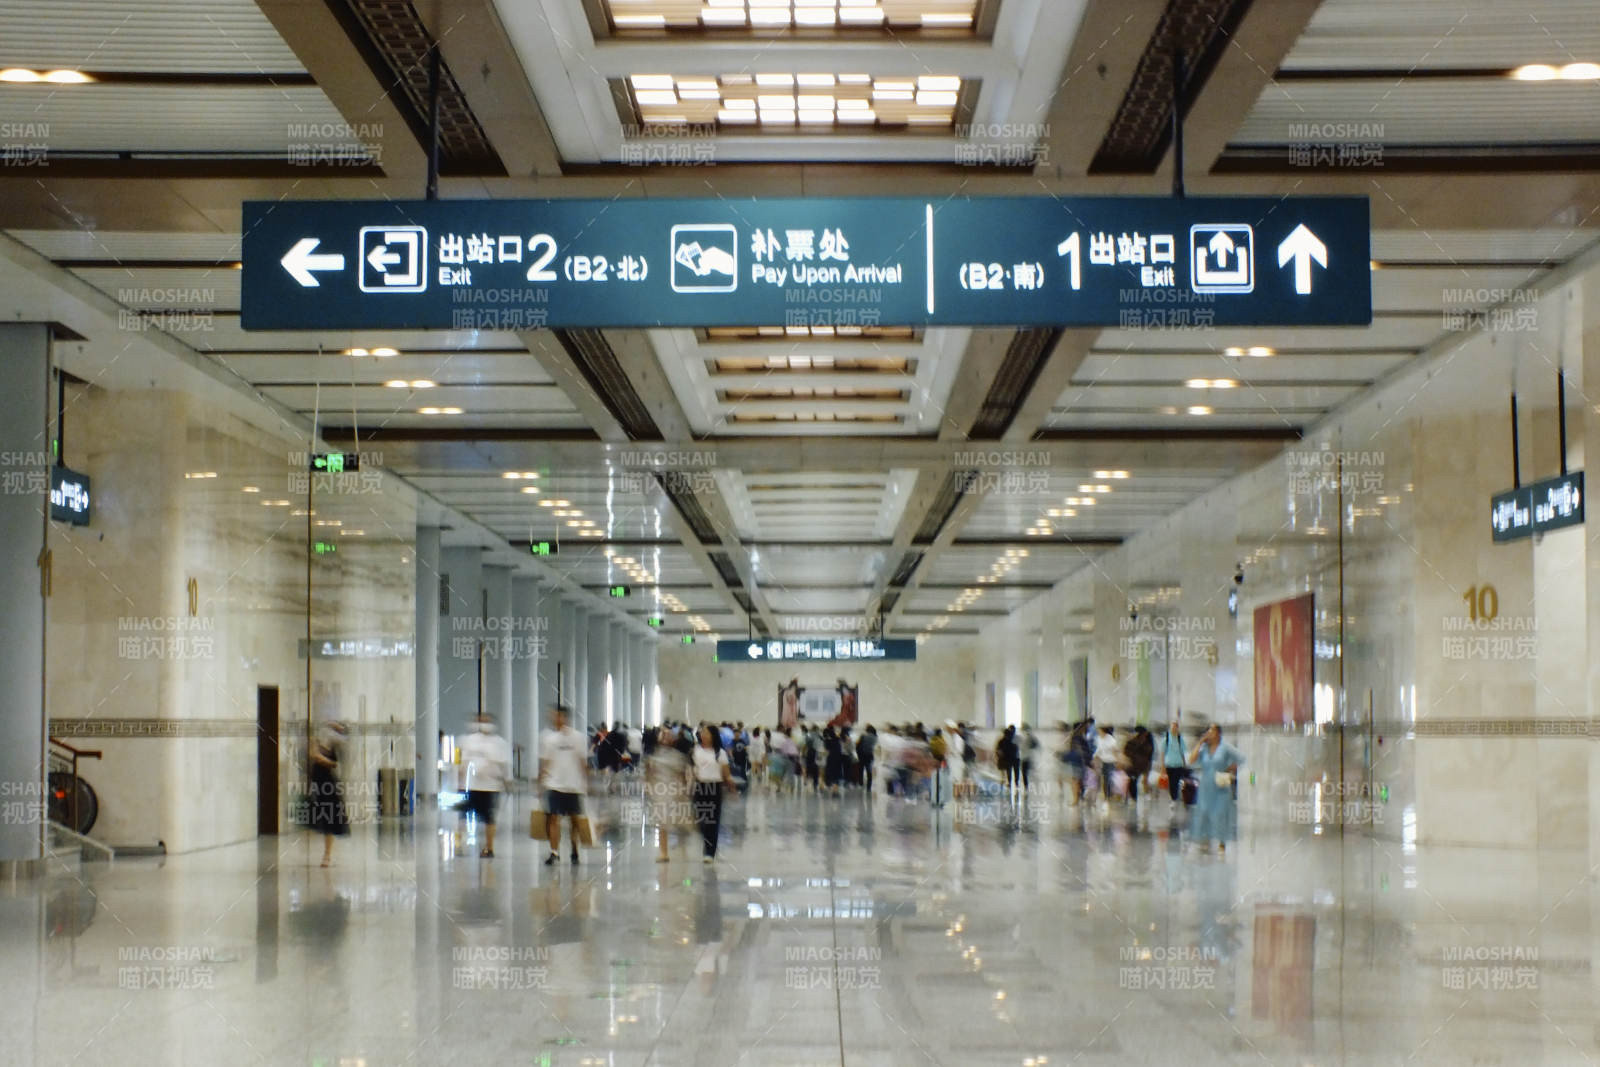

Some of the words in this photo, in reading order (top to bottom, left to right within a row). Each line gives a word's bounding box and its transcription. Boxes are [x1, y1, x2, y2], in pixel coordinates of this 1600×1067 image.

[438, 233, 523, 265] 出站口
[526, 233, 558, 282] 2
[751, 228, 850, 262] 补票处
[1057, 231, 1080, 290] 1
[1089, 231, 1176, 266] 出站口
[438, 267, 473, 286] Exit
[752, 264, 787, 287] Pay
[792, 264, 840, 287] Upon
[844, 264, 902, 284] Arrival
[1140, 265, 1175, 287] Exit
[1463, 584, 1499, 622] 10
